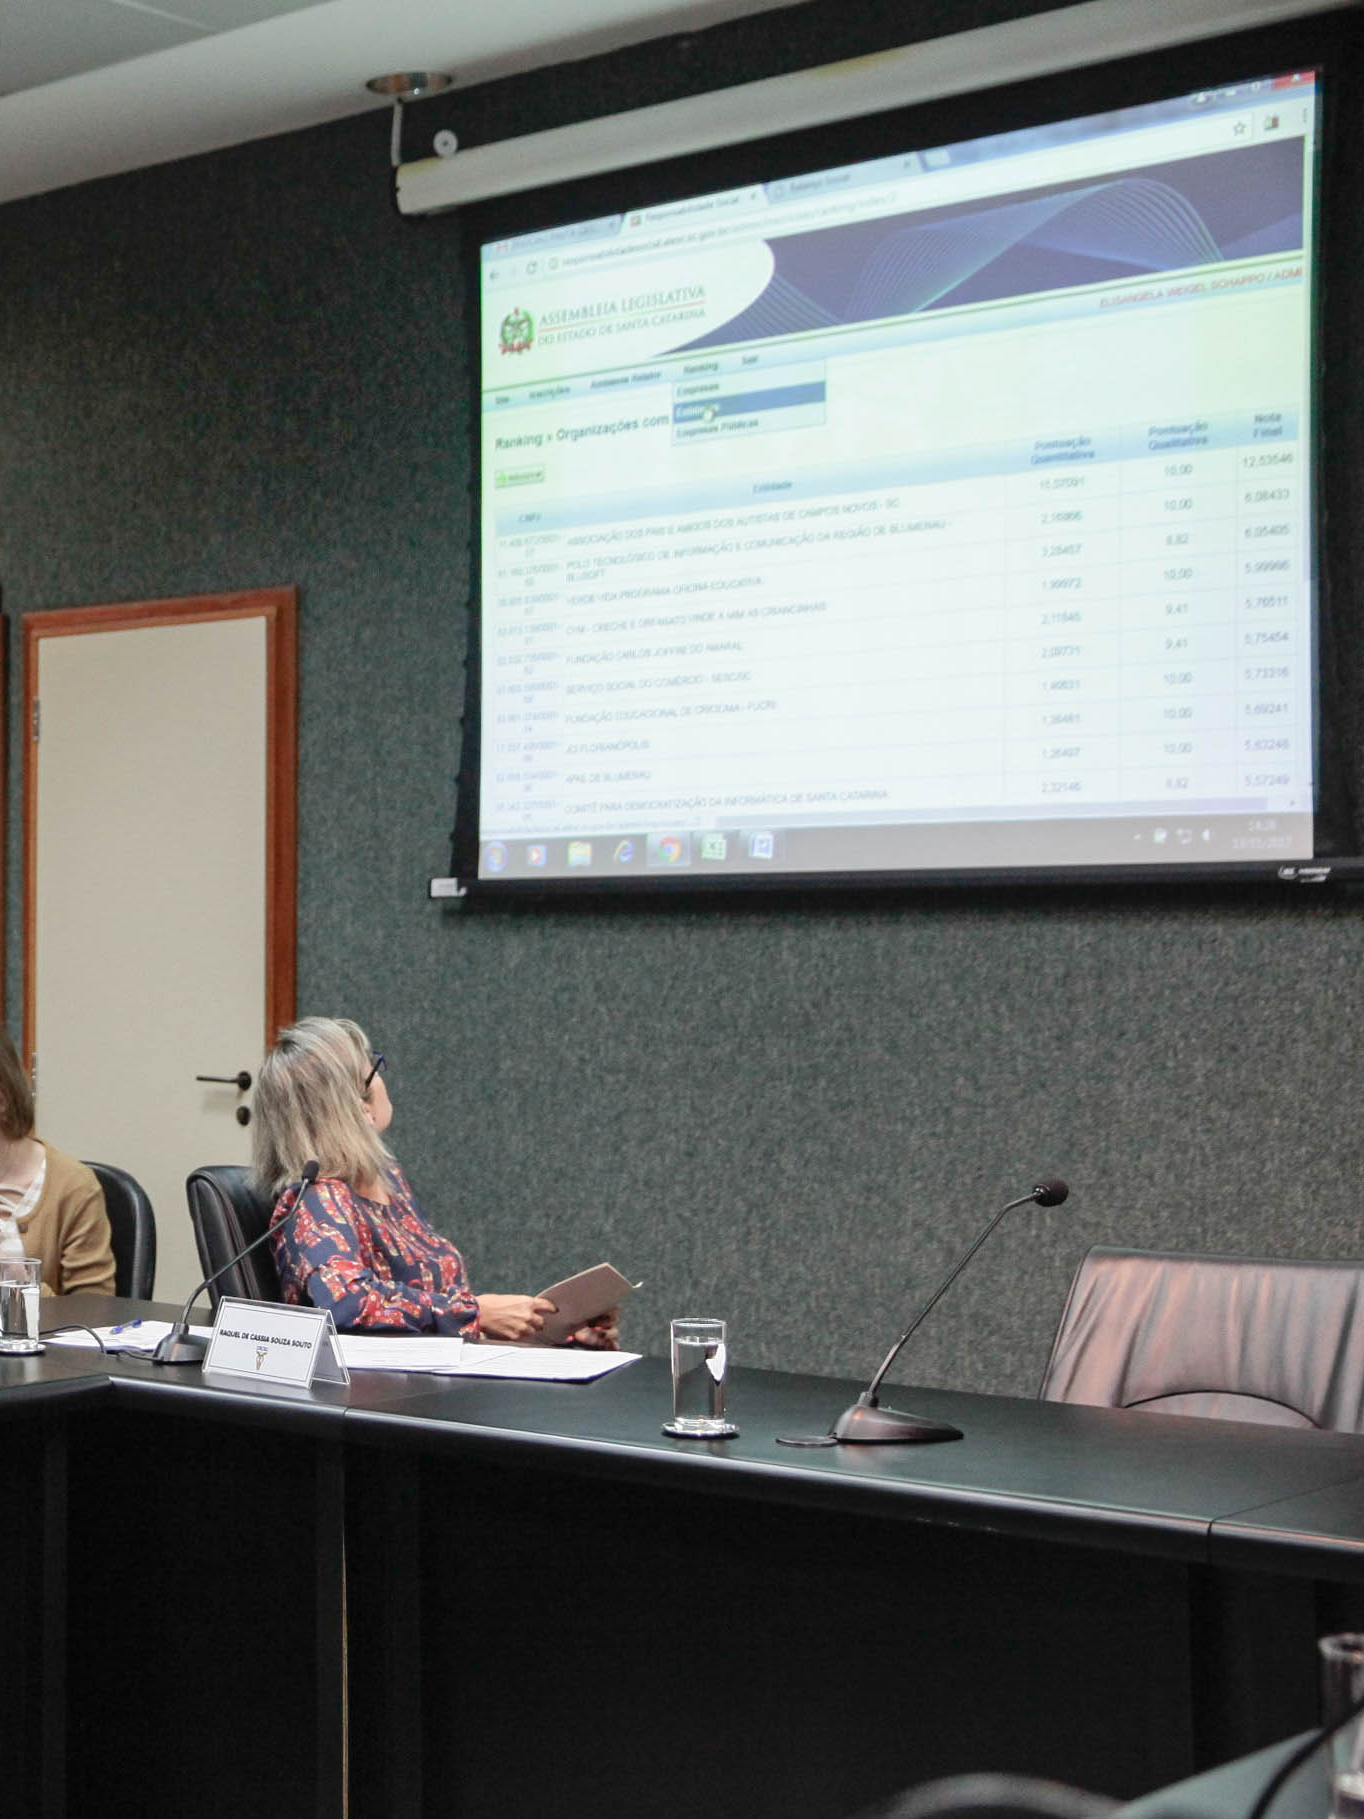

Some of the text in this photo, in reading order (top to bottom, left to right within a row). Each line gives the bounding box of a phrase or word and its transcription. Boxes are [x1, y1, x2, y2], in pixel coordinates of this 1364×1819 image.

[539, 285, 705, 326] ASSEMBLEIA LEGISLATIVA
[538, 308, 706, 346] DO ESTADO DE SANTA CATARINA
[495, 414, 669, 450] Ranking Organizações com
[1164, 464, 1193, 477] 10,00
[1164, 499, 1193, 511] 10,00
[1164, 568, 1193, 581] 10,00
[219, 1328, 312, 1349] RAQUEL DE CASSIA SOUZA SOUTO
